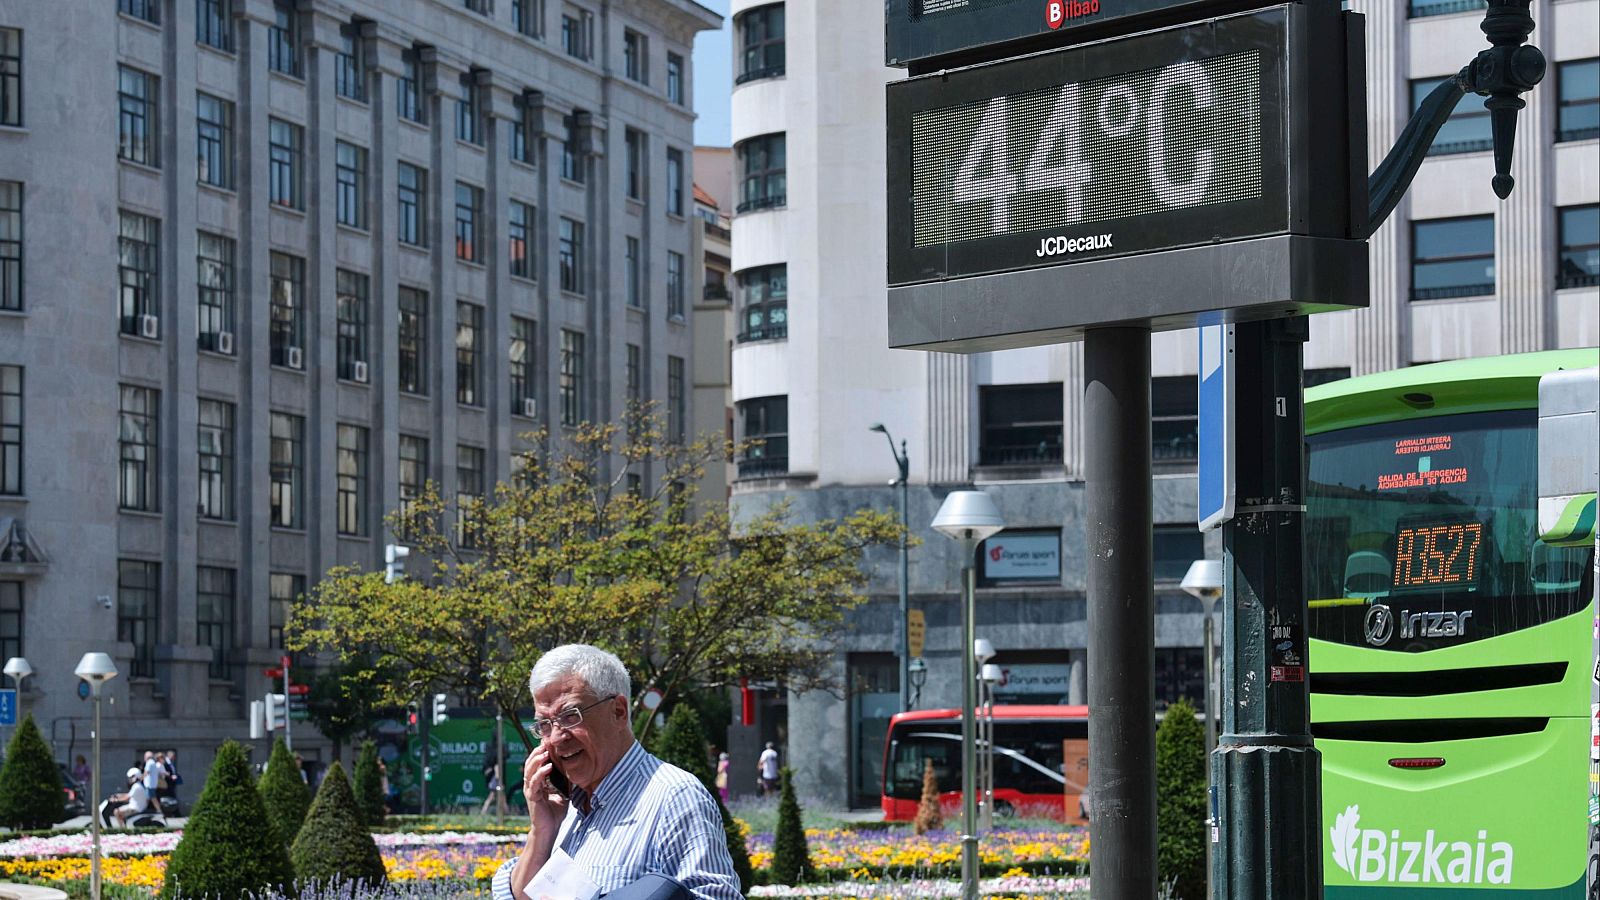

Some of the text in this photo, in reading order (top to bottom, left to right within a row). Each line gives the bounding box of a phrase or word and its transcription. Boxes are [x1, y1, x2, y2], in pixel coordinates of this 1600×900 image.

[1050, 0, 1099, 22] Bilbao
[1036, 233, 1113, 257] JCDecaux
[1395, 436, 1451, 448] LARRIALDI IRTEERA
[1378, 468, 1467, 482] SALIDA DE EMERGENCIA
[1394, 523, 1482, 585] A3527
[441, 741, 478, 753] BILBAO
[1358, 829, 1514, 885] Bizkaia
